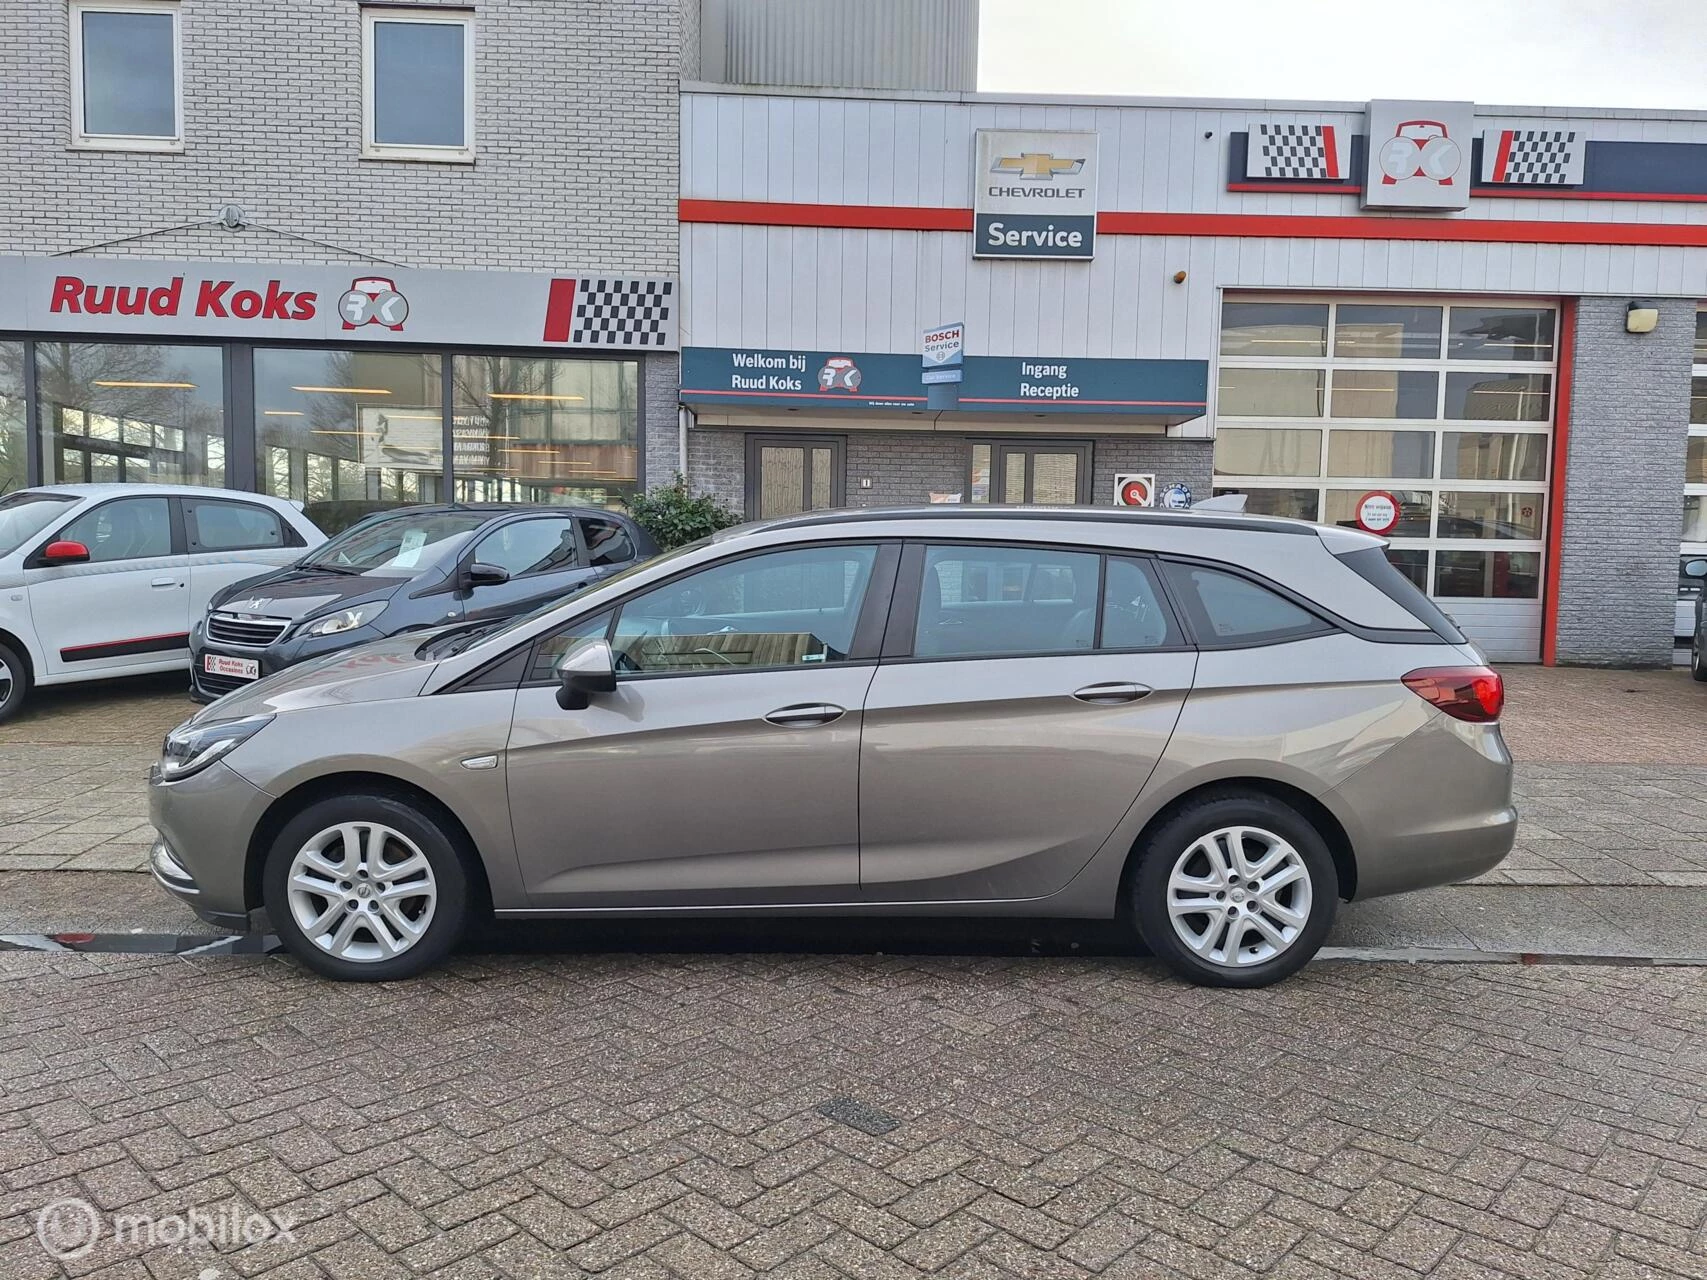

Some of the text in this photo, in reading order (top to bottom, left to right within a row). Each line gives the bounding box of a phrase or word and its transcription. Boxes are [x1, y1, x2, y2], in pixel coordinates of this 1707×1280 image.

[988, 186, 1086, 199] CHEVROLET
[988, 222, 1083, 247] Service
[50, 275, 318, 321] Ruud Koks
[925, 329, 960, 344] BOSCH
[925, 341, 960, 352] Service
[732, 353, 807, 372] Welkom bij
[1022, 362, 1068, 379] Ingang
[731, 375, 802, 390] Ruud Koks
[1020, 382, 1079, 400] Receptie
[218, 658, 244, 668] Ruud Koks
[219, 665, 244, 674] Occasions
